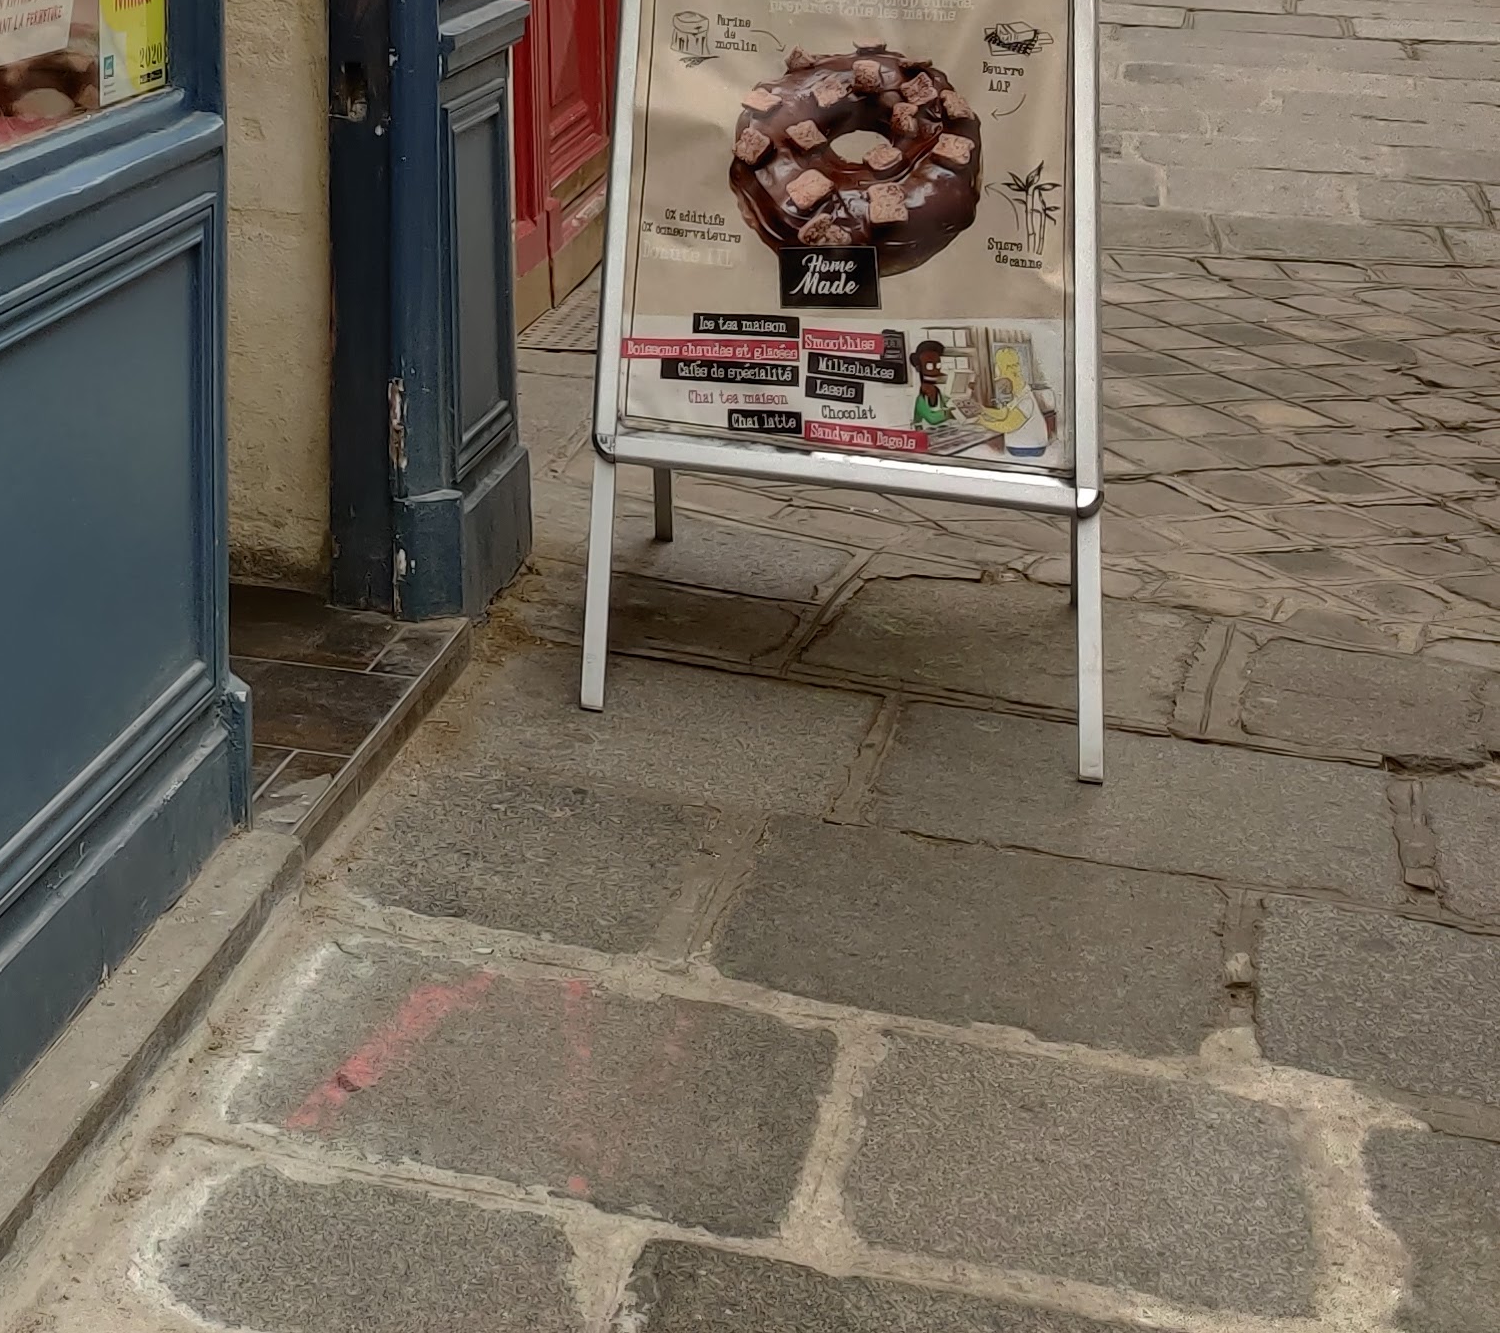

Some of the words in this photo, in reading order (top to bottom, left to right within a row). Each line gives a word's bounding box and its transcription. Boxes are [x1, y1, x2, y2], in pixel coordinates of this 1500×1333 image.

[724, 27, 736, 39] de
[715, 39, 758, 52] moulin
[139, 42, 163, 69] 2020
[987, 237, 1023, 252] Sucre
[801, 253, 858, 273] Home
[995, 250, 1008, 264] de
[1009, 257, 1042, 269] canne
[789, 271, 860, 295] Made
[718, 316, 738, 331] tea
[741, 318, 788, 333] maison
[804, 334, 876, 351] Smoothies
[677, 360, 708, 378] Cafés
[710, 363, 725, 378] de
[727, 363, 793, 381] spécialité
[818, 356, 895, 380] Milkshakes
[688, 389, 714, 404] Chai
[720, 390, 739, 404] tea
[742, 392, 788, 405] maison
[731, 413, 758, 428] Chai
[762, 413, 797, 429] latte
[821, 405, 877, 420] Chocolat
[810, 422, 873, 446] Sandwich
